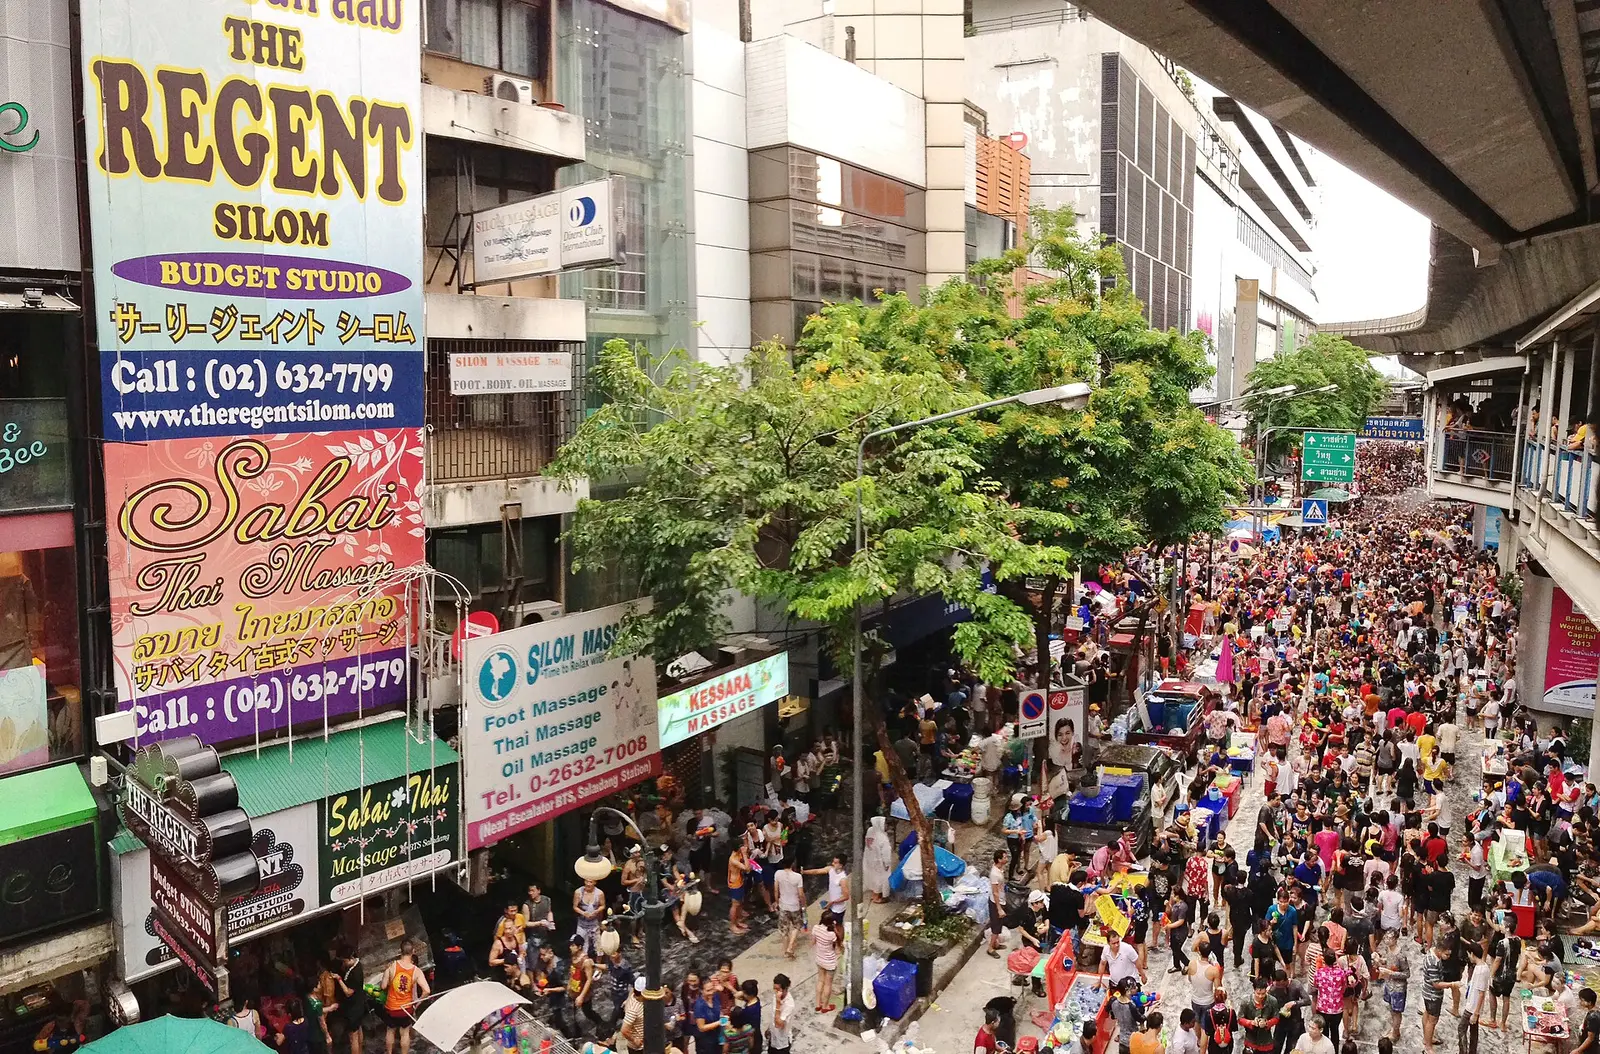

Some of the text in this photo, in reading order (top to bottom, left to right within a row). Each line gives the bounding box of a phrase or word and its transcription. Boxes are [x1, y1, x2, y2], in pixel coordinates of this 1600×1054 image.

[225, 18, 303, 70] THE
[94, 60, 411, 202] REGENT
[215, 203, 329, 247] SILOM
[585, 224, 603, 237] Club
[160, 261, 382, 293] BUDGET STUDIO
[337, 310, 416, 345] シーロム
[111, 359, 178, 393] Call
[205, 358, 267, 398] (02)
[276, 361, 393, 393] 632-7799
[455, 357, 488, 367] SILOM
[496, 356, 540, 367] MASSAGE
[3, 423, 21, 442] &
[112, 400, 394, 429] www.theregentsilom.com
[117, 438, 397, 552] Sabai
[131, 539, 394, 616] Thai Massage
[1560, 623, 1582, 631] World
[1565, 616, 1592, 625] Bangk
[1567, 632, 1596, 640] Capital
[132, 623, 223, 660] สบาย
[527, 634, 575, 686] SILOM
[582, 622, 620, 656] MASS
[1571, 639, 1591, 647] 2013
[224, 678, 283, 723] (02)
[291, 657, 406, 702] 632-7579
[484, 684, 608, 732] Foot Massage
[690, 673, 751, 712] KESSARA
[493, 711, 601, 755] Thai Massage
[688, 694, 755, 733] MASSAGE
[482, 735, 647, 809] Tel. 0-2632-7008
[502, 736, 597, 778] Oil Massage
[126, 781, 199, 860] THE REGENT
[329, 774, 449, 837] Sabai Thai
[479, 818, 507, 842] (Near
[508, 800, 554, 827] Escalator
[621, 760, 651, 782] Station)
[150, 826, 175, 855] SILOM
[330, 845, 398, 879] Massage
[153, 864, 178, 902] Budget
[180, 892, 211, 935] STUDIO
[229, 906, 254, 920] DGET
[257, 892, 293, 911] STUDIO
[258, 903, 293, 921] TRAVEL
